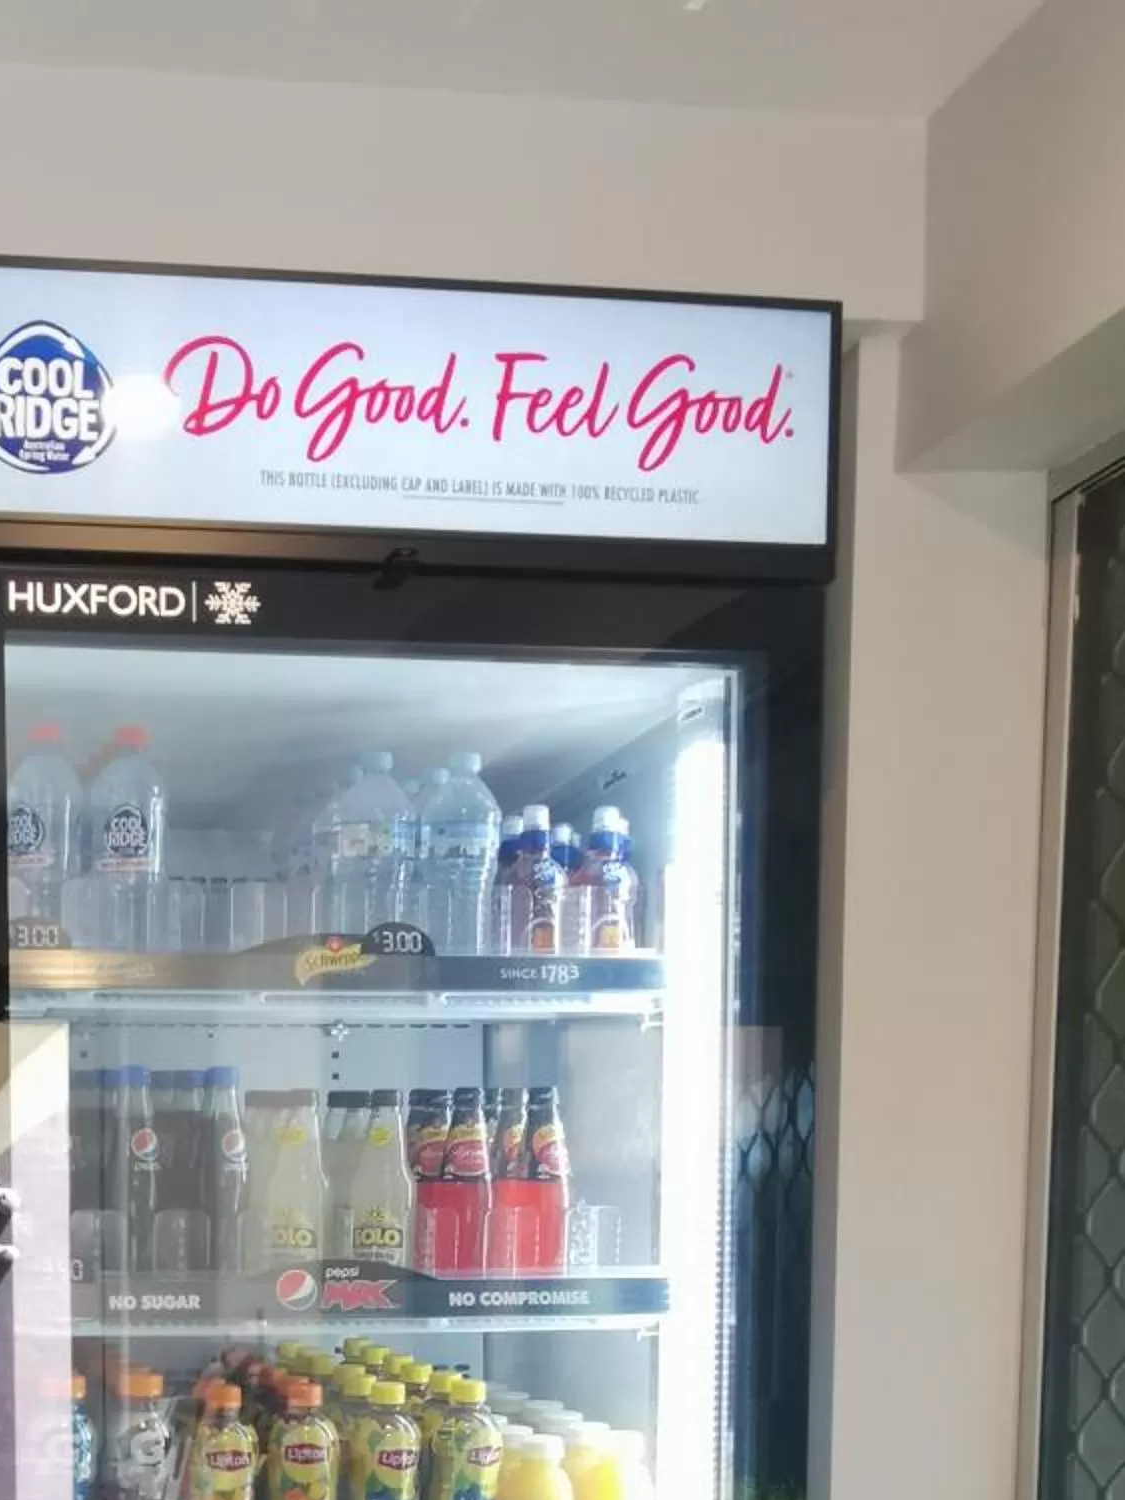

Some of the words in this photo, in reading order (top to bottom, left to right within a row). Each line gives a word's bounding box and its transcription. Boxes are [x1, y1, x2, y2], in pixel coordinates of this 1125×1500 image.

[163, 335, 281, 436] Do
[294, 342, 469, 462] Good.
[492, 352, 619, 442] Feel
[627, 354, 794, 471] Good.
[260, 470, 284, 487] THIS
[288, 472, 326, 488] BOTTLE
[401, 477, 423, 491] CAP
[426, 478, 448, 493] AND
[492, 480, 503, 495] IS
[505, 481, 535, 497] MADE
[539, 483, 567, 498] WITH
[571, 484, 600, 500] 100%
[604, 486, 655, 502] RECYCLED
[658, 488, 700, 505] PLASTIC
[8, 580, 186, 617] HUXFORD
[500, 966, 537, 979] SINCE
[540, 964, 580, 984] 1783
[109, 1295, 136, 1310] NO
[141, 1294, 201, 1309] SUGAR
[448, 1291, 475, 1306] NO
[479, 1290, 590, 1306] COMPROMISE
